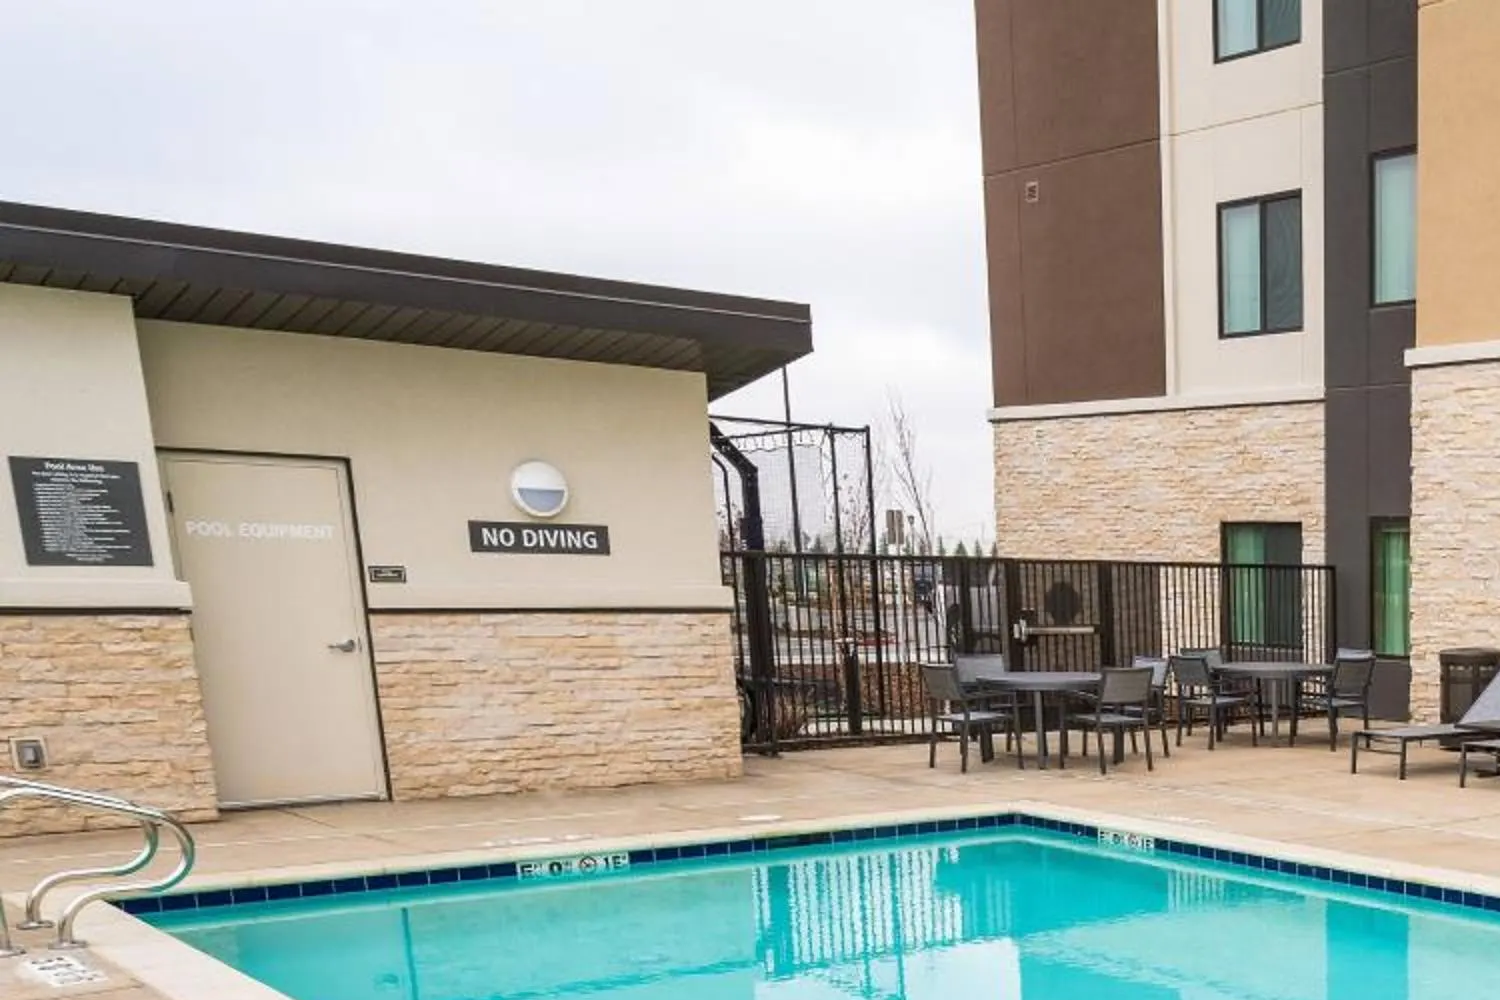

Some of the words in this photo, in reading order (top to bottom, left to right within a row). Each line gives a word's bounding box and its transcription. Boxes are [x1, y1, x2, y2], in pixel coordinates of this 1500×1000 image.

[185, 520, 233, 537] POOL
[239, 522, 334, 538] EQUIPMENT
[481, 527, 515, 547] NO
[521, 529, 598, 549] DIVING
